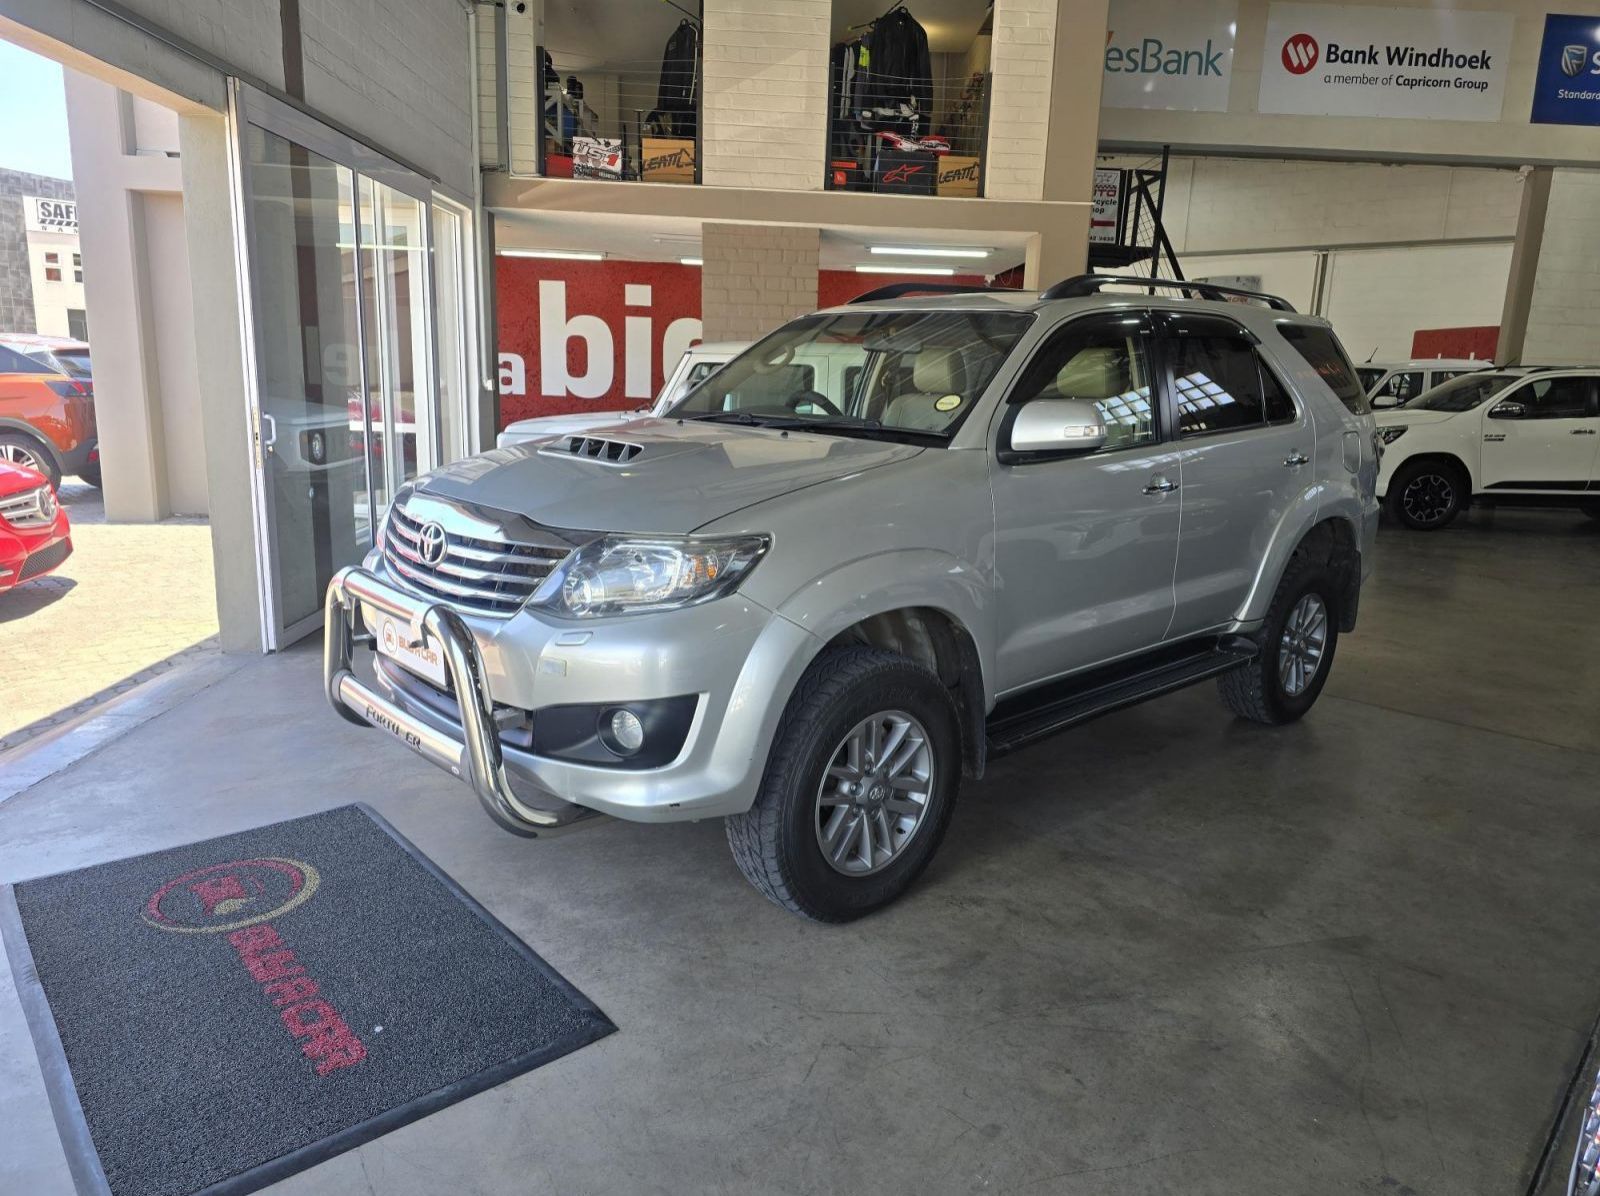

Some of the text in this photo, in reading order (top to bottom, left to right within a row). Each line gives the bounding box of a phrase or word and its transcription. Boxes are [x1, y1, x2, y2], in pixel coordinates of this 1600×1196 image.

[1104, 31, 1223, 76] esBank
[1325, 43, 1492, 70] Bank Windhoek
[1323, 72, 1489, 92] a member of Capricorn Group
